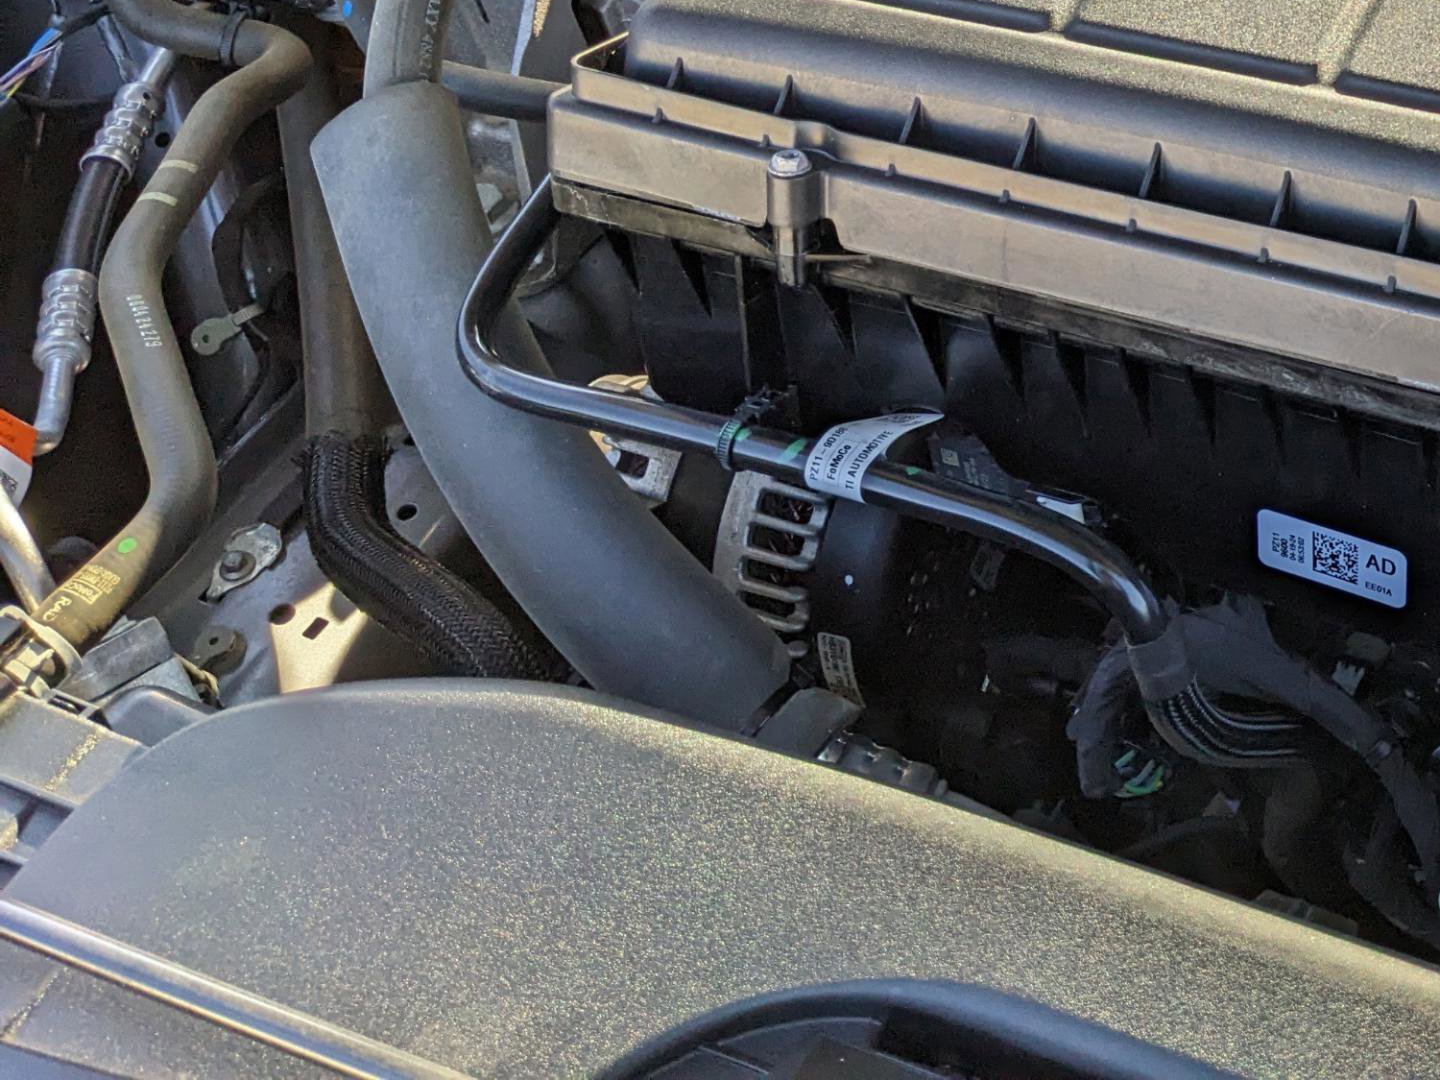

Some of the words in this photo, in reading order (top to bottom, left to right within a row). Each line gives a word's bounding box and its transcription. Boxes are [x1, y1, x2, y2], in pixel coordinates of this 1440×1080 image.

[827, 444, 852, 480] FoMoCo
[848, 430, 894, 478] AUTOMOTIVE
[845, 480, 855, 490] TI
[1365, 553, 1397, 576] AD
[1364, 581, 1393, 597] EE01A
